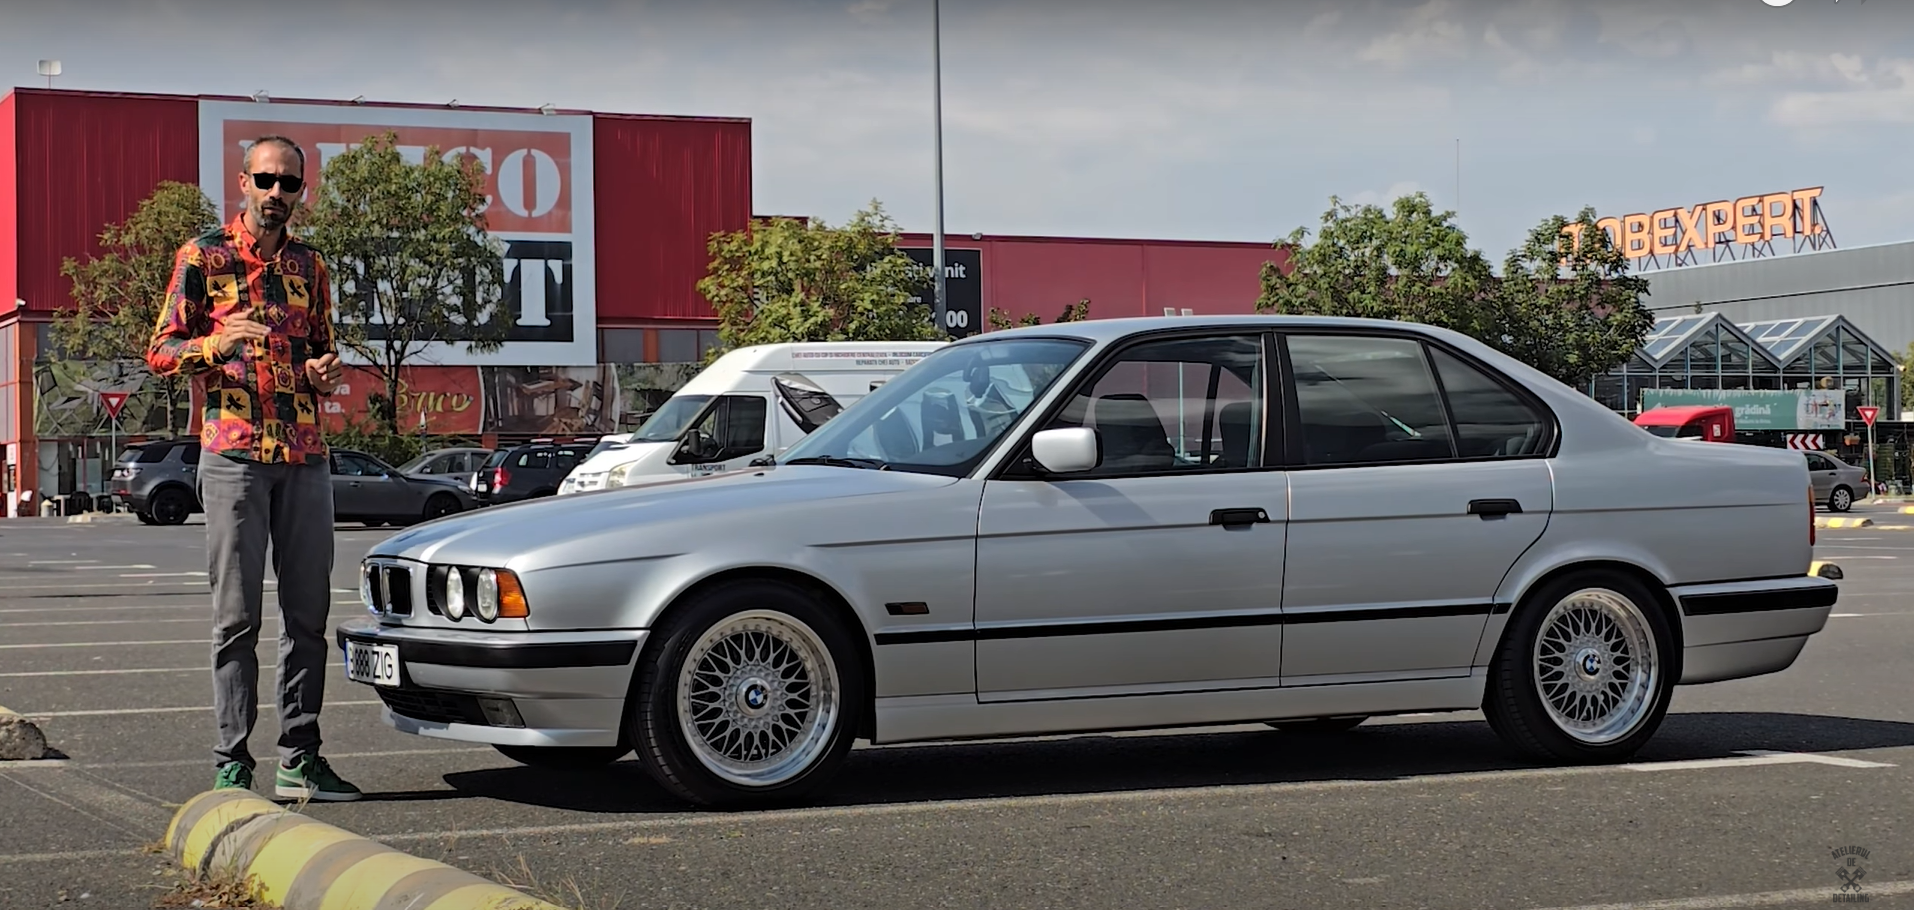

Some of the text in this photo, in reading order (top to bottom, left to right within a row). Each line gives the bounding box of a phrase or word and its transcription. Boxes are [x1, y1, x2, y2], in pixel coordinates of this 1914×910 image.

[927, 262, 966, 278] vnit
[1735, 404, 1771, 417] grădină
[355, 647, 370, 678] 888
[371, 650, 393, 680] ZIG
